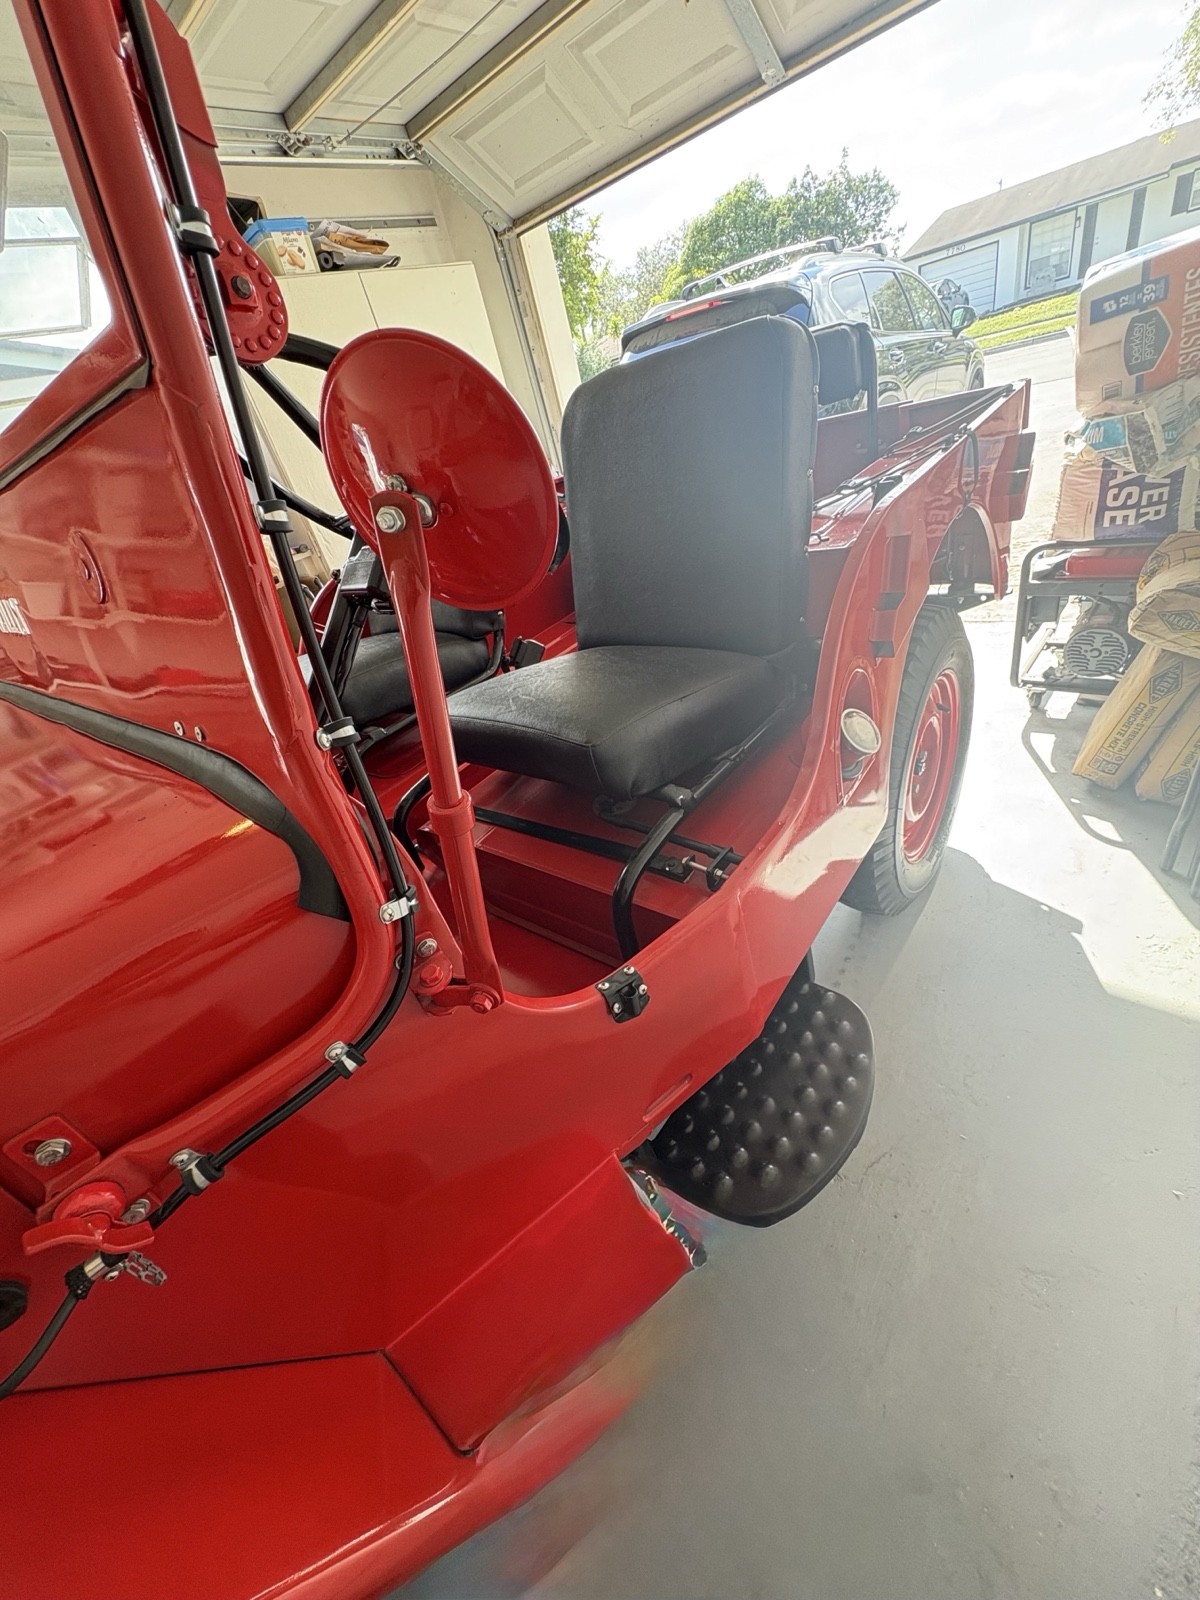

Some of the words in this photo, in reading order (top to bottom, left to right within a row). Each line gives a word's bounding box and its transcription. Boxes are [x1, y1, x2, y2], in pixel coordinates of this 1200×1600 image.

[1119, 294, 1129, 308] 12
[1128, 323, 1144, 366] berkley
[1116, 702, 1147, 738] CONCRETE
[1107, 735, 1122, 751] MIX
